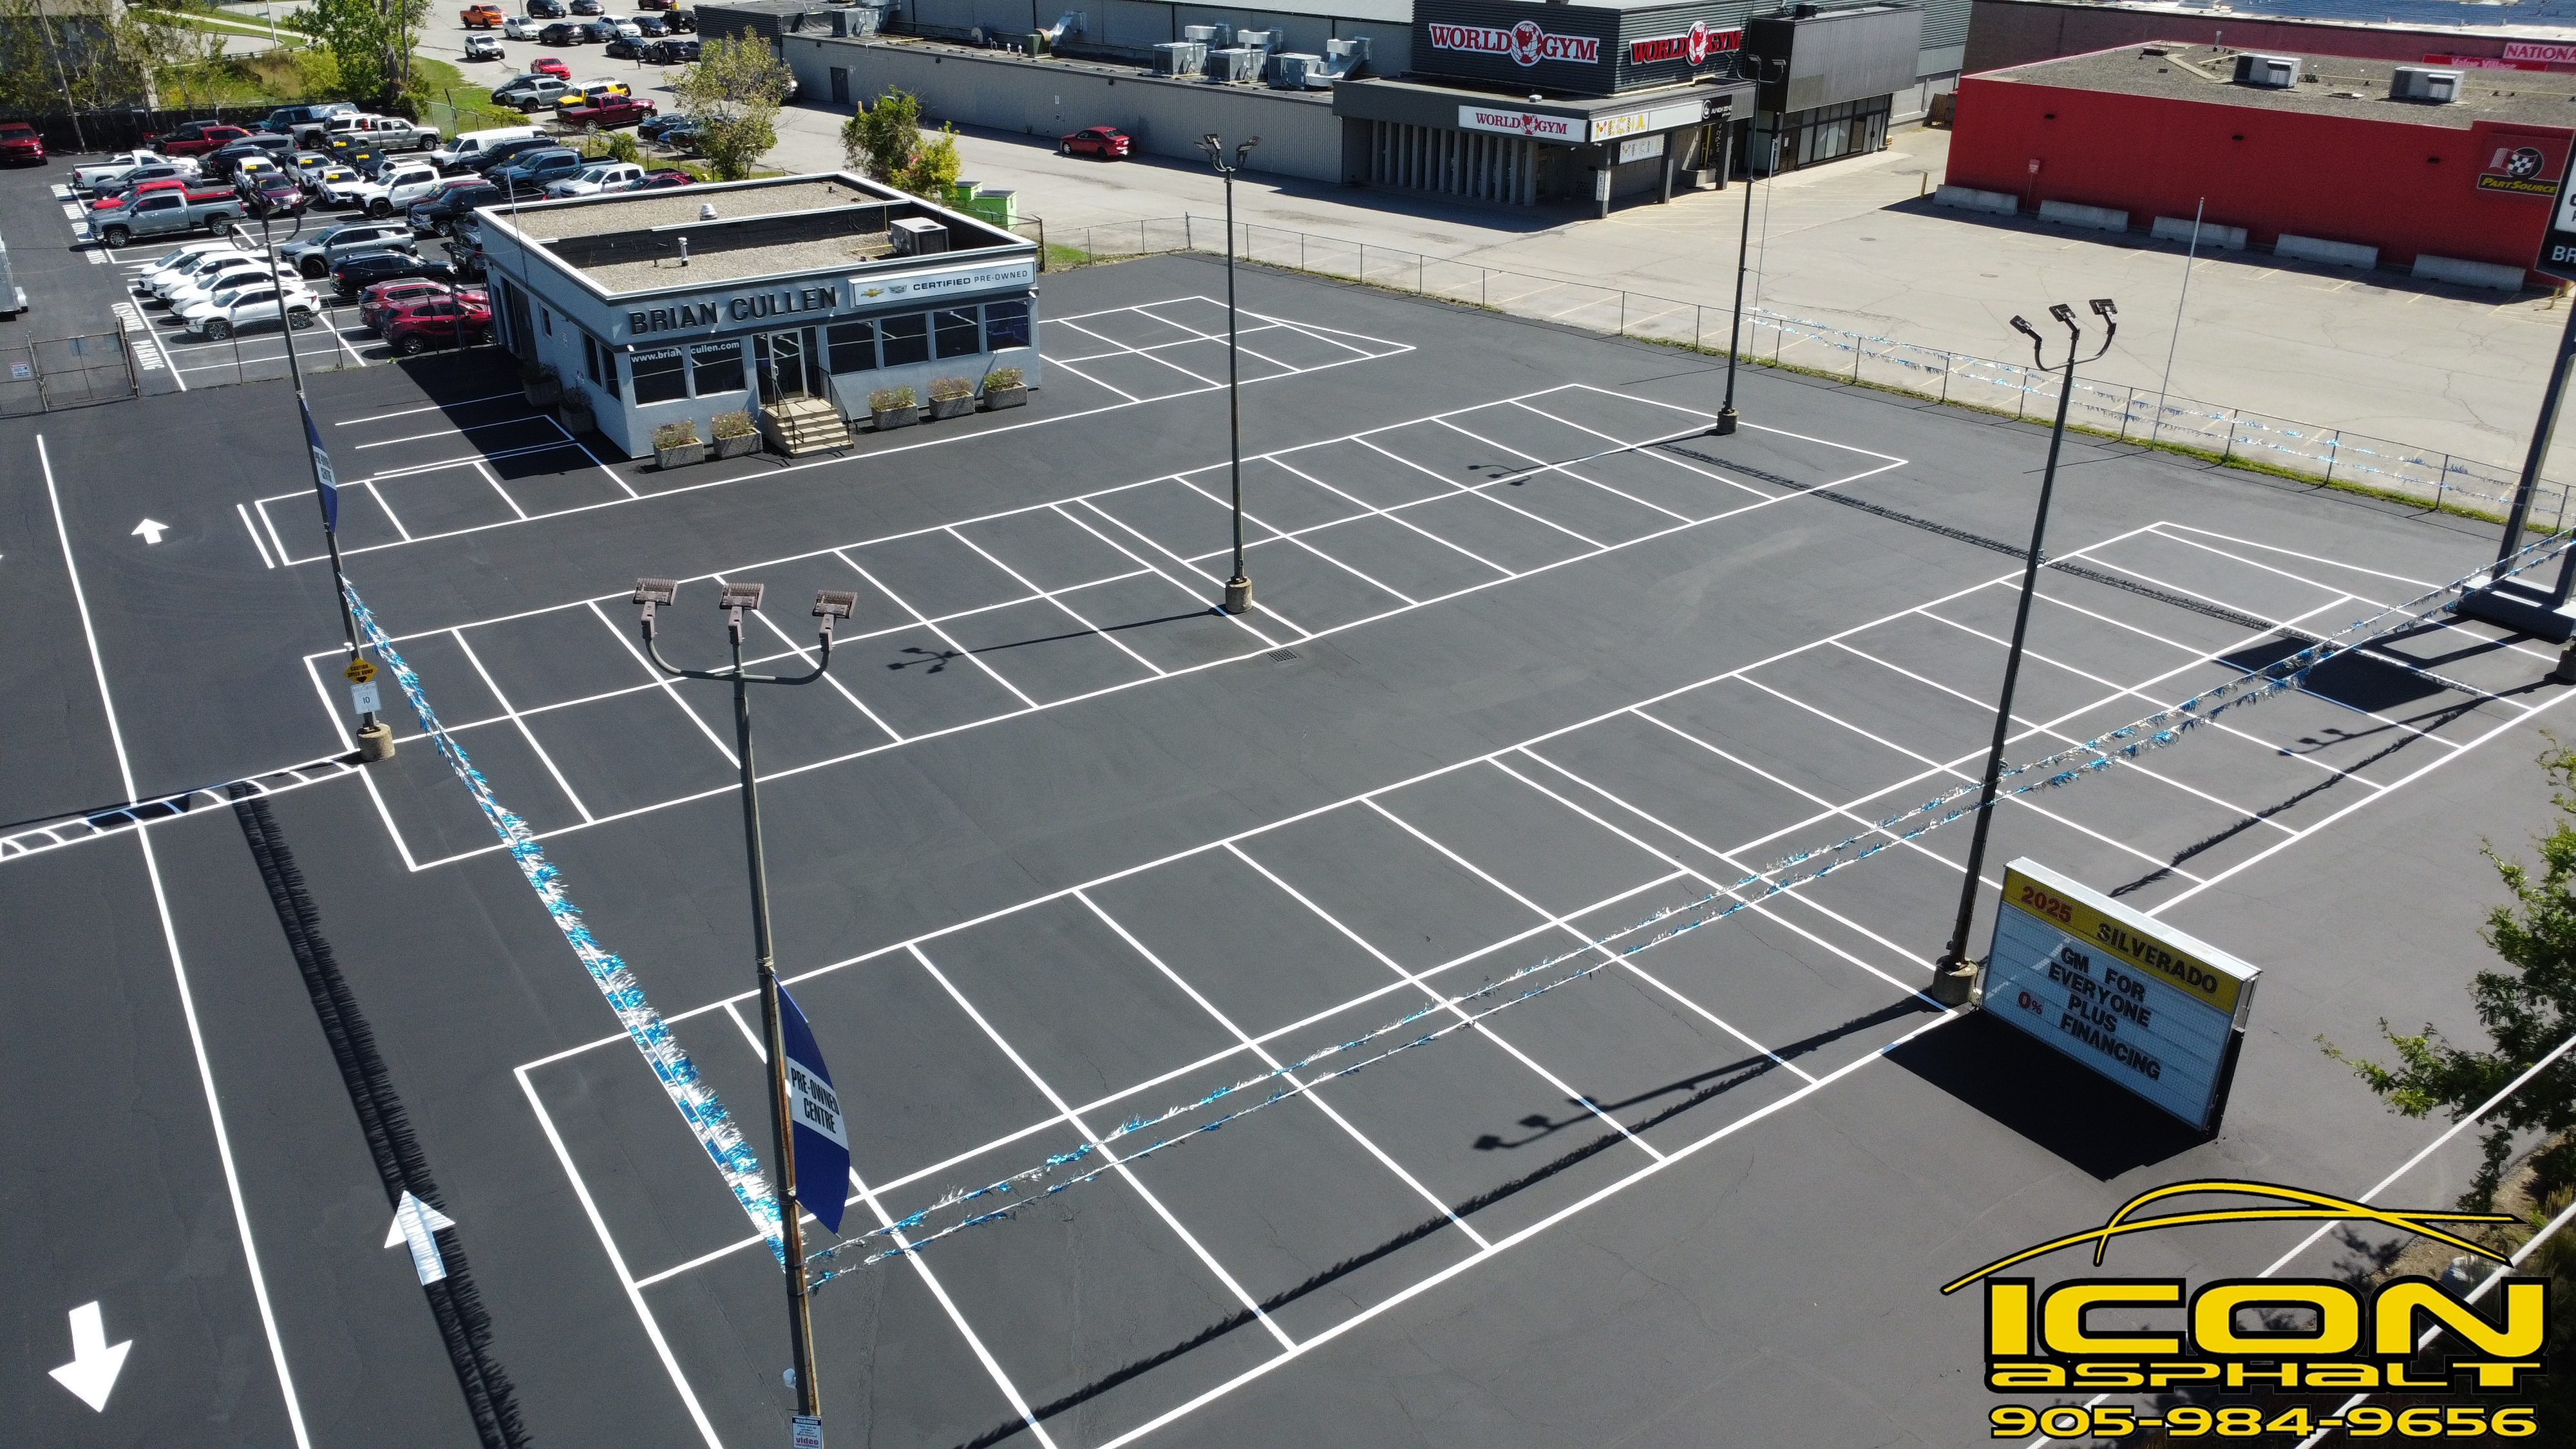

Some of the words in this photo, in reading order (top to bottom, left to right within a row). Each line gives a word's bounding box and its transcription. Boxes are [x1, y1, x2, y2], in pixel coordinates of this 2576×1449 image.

[1431, 26, 1511, 52] WORLD
[1542, 36, 1597, 61] GYM
[1632, 36, 1690, 63] WORLD
[1707, 30, 1741, 53] GYM
[2506, 45, 2576, 61] NATIONA
[1475, 112, 1520, 128] WORLD
[1537, 120, 1567, 135] GYM
[913, 278, 971, 291] CERTIFIED
[974, 270, 1028, 283] PRE-OWNED
[628, 301, 719, 336] BRIAN
[730, 285, 837, 322] CULLEN
[131, 339, 165, 370] PARKING
[630, 348, 682, 363] www.brian
[690, 341, 740, 355] cullen.com
[2022, 885, 2072, 923] 2025
[2061, 947, 2089, 973] GM
[2105, 968, 2145, 1002] FOR
[2097, 922, 2219, 995] SILVERADO
[2048, 961, 2152, 1028] EVERYONE
[2068, 994, 2117, 1032] PLUS
[2018, 991, 2043, 1015] 0%
[2060, 1014, 2161, 1081] FINANCING
[791, 1066, 840, 1117] PRE-OWNED
[804, 1097, 837, 1135] CENTRE
[796, 1437, 819, 1445] video
